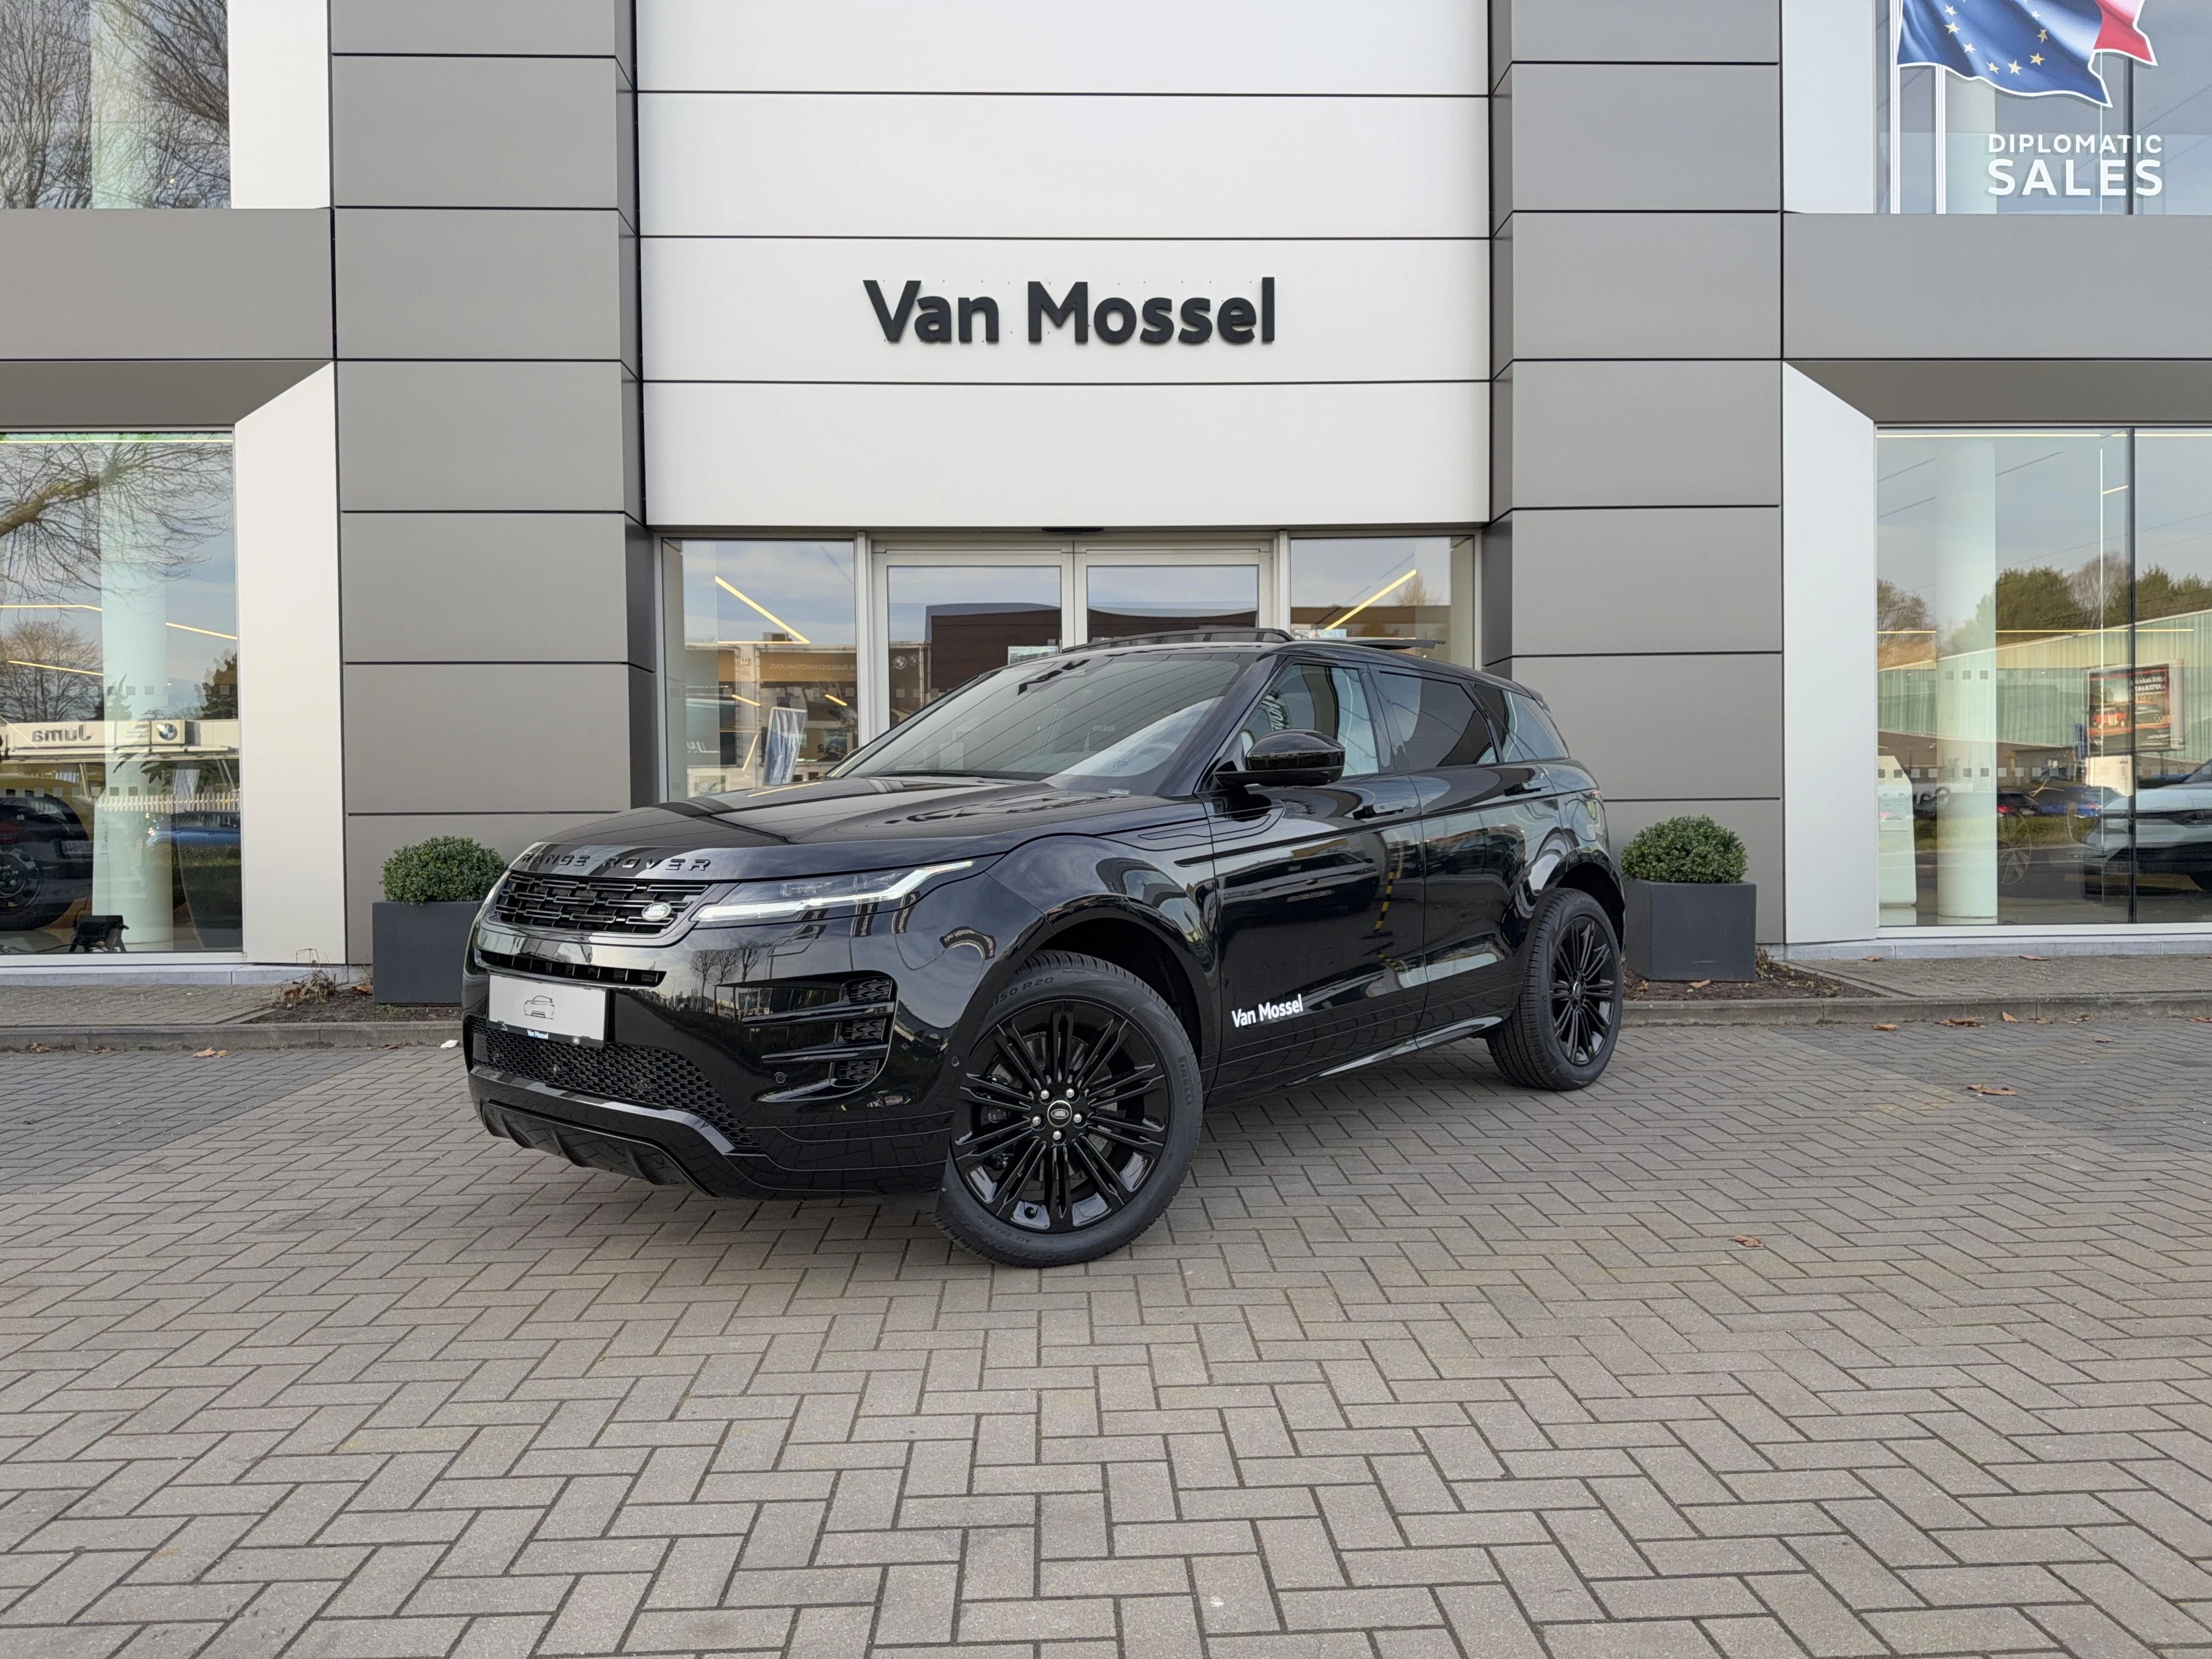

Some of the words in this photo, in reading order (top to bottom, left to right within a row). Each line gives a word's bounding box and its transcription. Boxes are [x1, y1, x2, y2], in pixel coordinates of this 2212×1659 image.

[1988, 134, 2163, 153] DIPLOMATIC
[1988, 159, 2163, 196] SALES
[862, 280, 999, 344] Van
[1028, 276, 1276, 344] Mossel
[520, 851, 591, 867] RANGE
[602, 856, 712, 872] ROVER
[1022, 977, 1054, 991] R20
[1231, 1008, 1256, 1028] Van
[1258, 994, 1304, 1022] Mossel
[535, 1031, 549, 1040] Mossel
